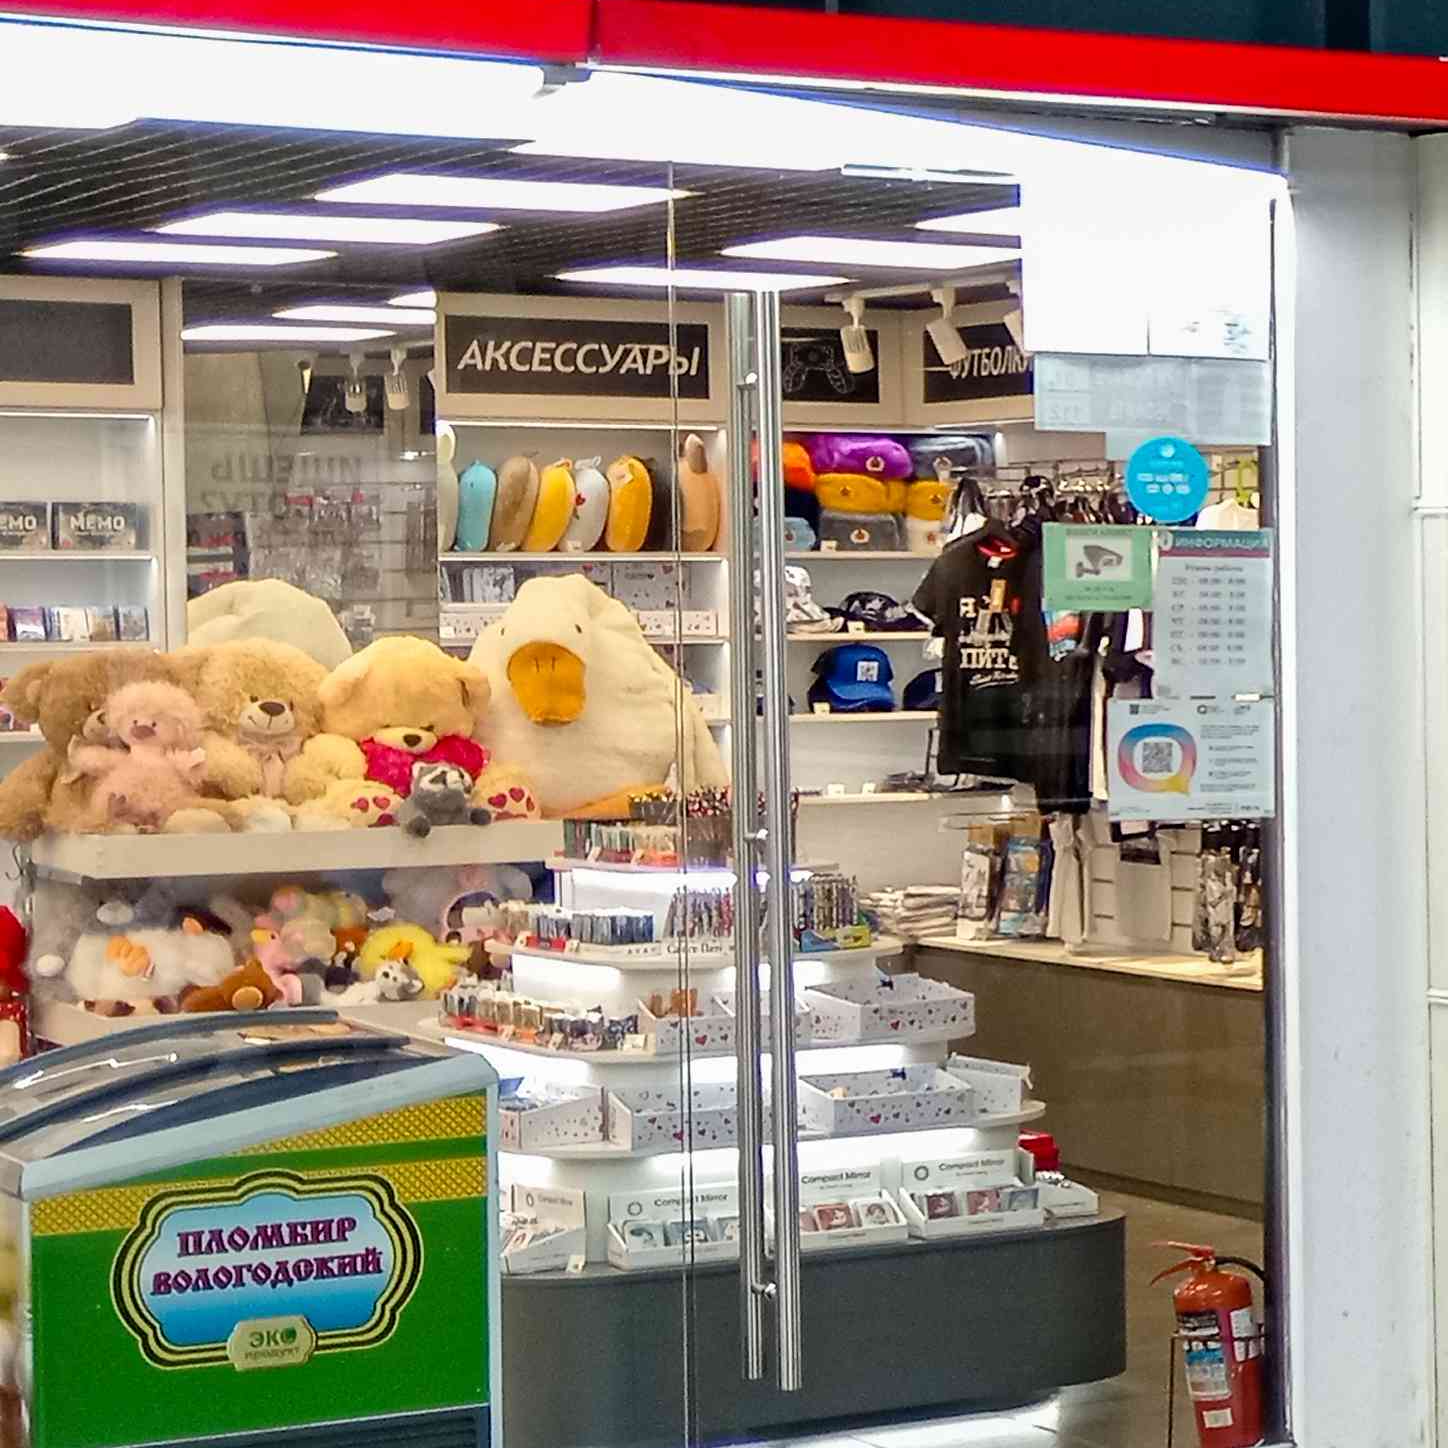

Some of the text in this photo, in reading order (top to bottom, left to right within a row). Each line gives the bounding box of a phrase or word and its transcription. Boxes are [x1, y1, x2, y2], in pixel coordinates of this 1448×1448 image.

[457, 339, 701, 377] АКСЕССУАРЫ
[950, 345, 1033, 380] УТБОЛК
[70, 515, 126, 531] MEMO
[801, 1172, 844, 1185] Compact
[654, 1194, 700, 1207] Compt
[177, 1216, 357, 1258] ПЛОМБИР
[150, 1246, 383, 1297] ВОЛОГОДСКИЙ
[249, 1326, 297, 1349] ЭКО
